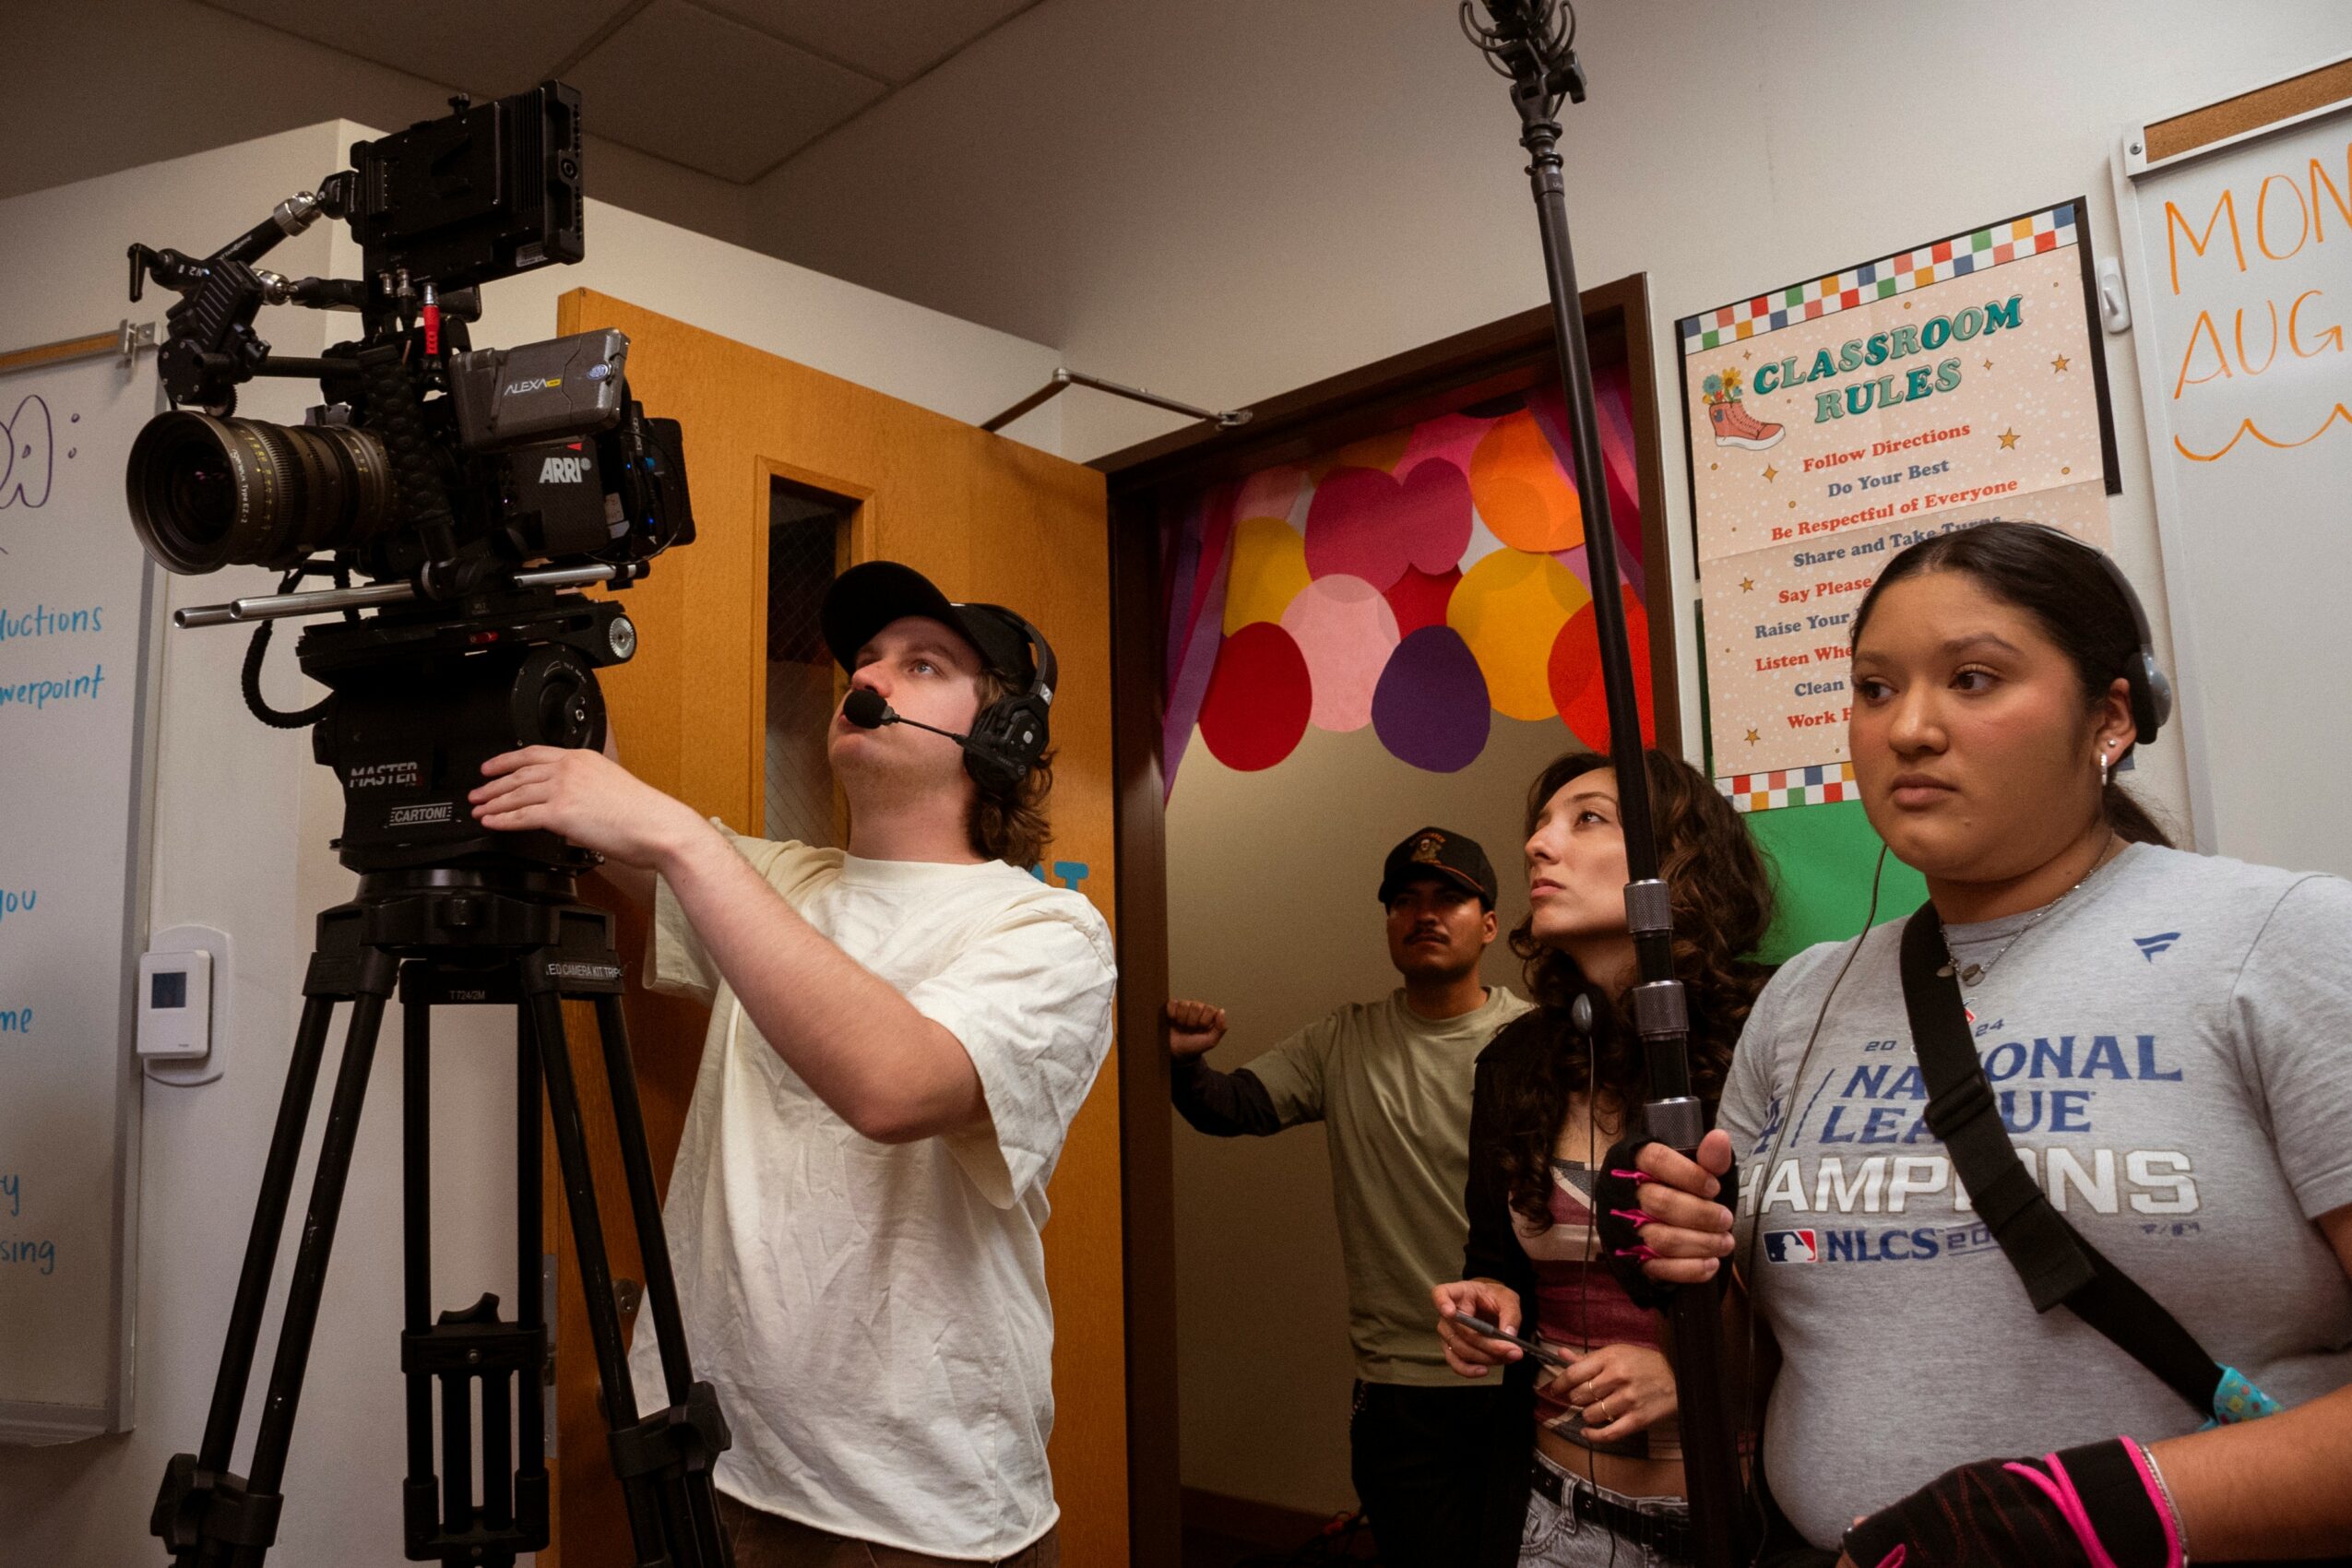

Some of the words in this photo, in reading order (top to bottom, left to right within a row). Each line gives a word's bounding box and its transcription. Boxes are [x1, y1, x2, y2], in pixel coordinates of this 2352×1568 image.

[2165, 142, 2352, 295] MON
[1753, 293, 2024, 396] CLASSROOM
[2173, 289, 2345, 400] AUG
[504, 377, 548, 397] ALEXA
[1814, 357, 1962, 424] RULES
[1802, 447, 1867, 473] Follow
[1871, 423, 1971, 457] Directions
[538, 457, 583, 483] ARRI
[1828, 480, 1853, 498] Do
[1859, 470, 1904, 492] Your
[1908, 459, 1950, 480] Best
[1771, 526, 1793, 541] Be
[1798, 503, 1895, 537] Respectful
[1899, 498, 1919, 515] of
[1924, 479, 2019, 508] Everyone
[1793, 546, 1846, 568] Share
[1851, 536, 1885, 557] and
[1889, 529, 1936, 548] Take
[1778, 588, 1811, 604] Say
[1816, 577, 1872, 598] Please
[1754, 621, 1802, 639] Raise
[1806, 612, 1850, 630] Your
[1755, 653, 1810, 672] Listen
[1814, 645, 1853, 662] Whe
[1794, 680, 1845, 696] Clean
[1787, 710, 1837, 730] Work
[350, 762, 418, 788] MASTER
[394, 807, 447, 823] CARTONI
[1864, 1039, 1897, 1051] 20
[1975, 1018, 2005, 1038] 24
[1840, 1035, 2183, 1100] NAONAL
[1825, 1228, 1940, 1263] NLCS
